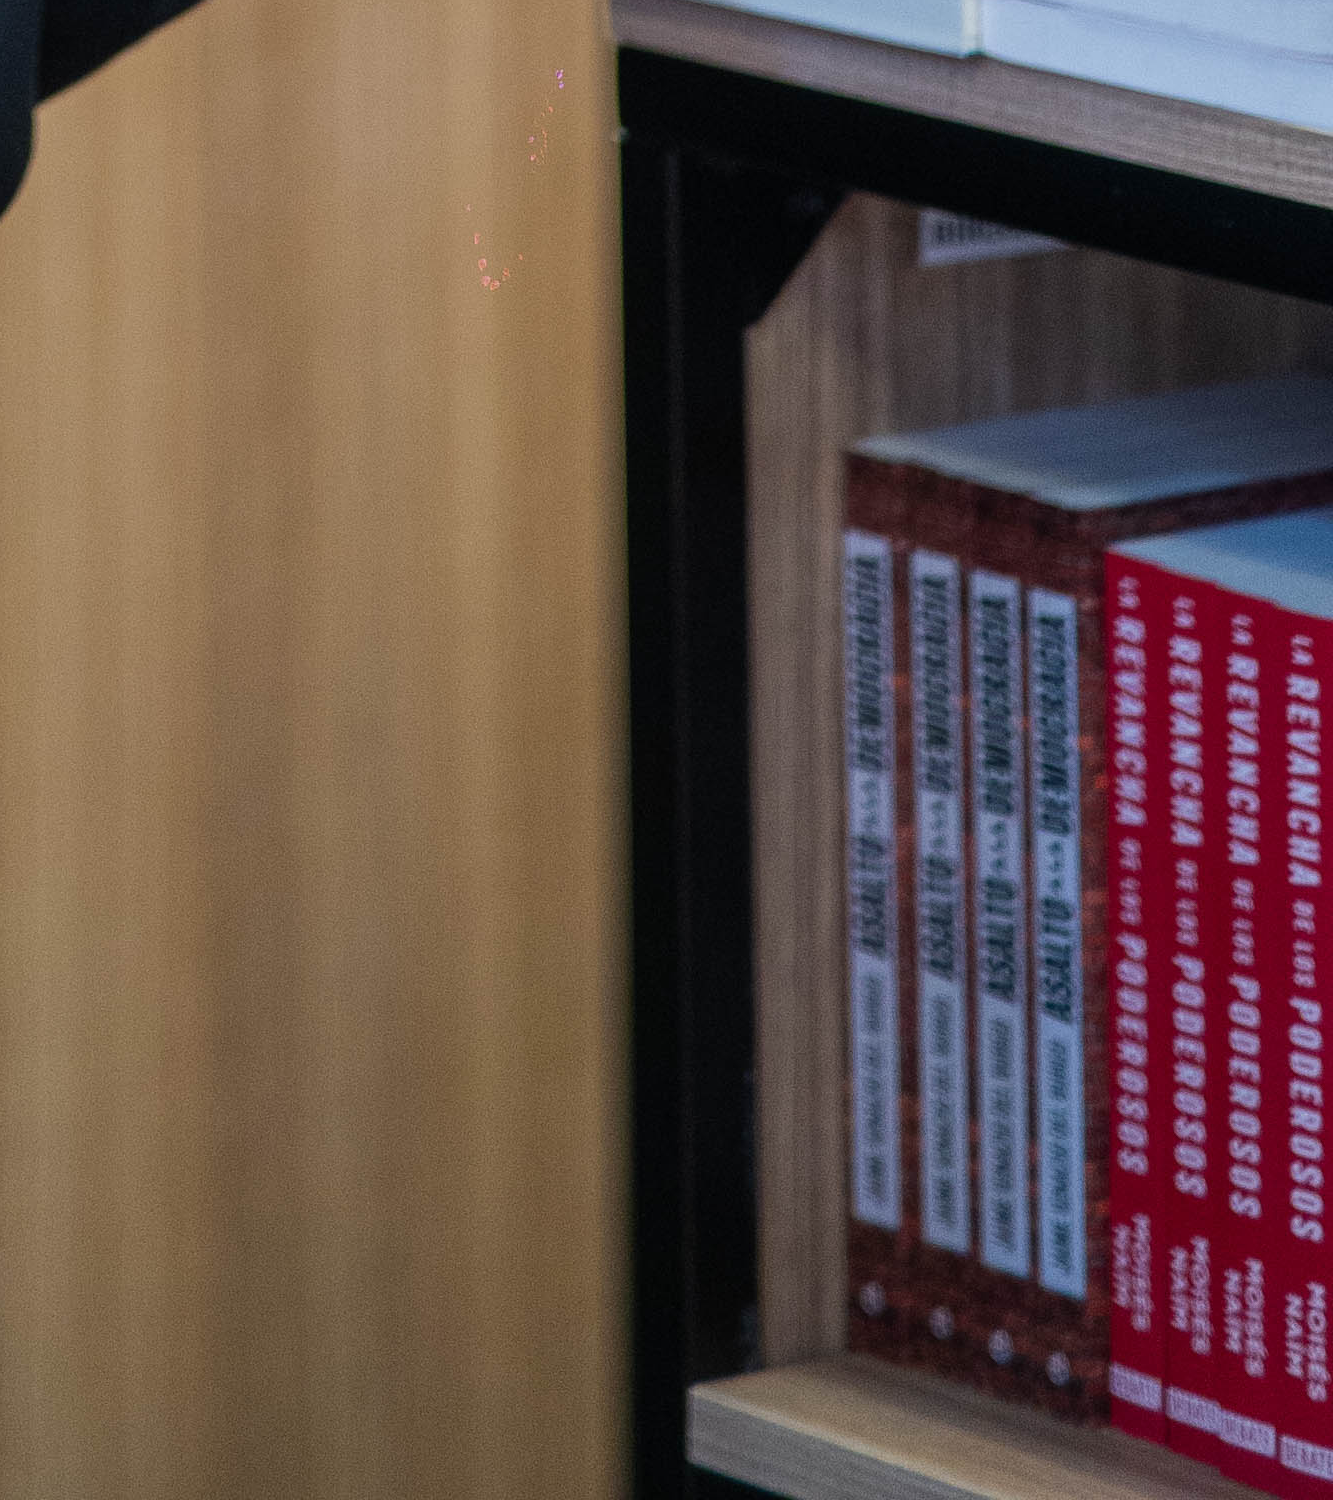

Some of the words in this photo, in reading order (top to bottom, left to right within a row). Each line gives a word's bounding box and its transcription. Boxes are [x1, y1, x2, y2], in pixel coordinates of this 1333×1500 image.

[1173, 596, 1195, 629] LA
[1231, 614, 1254, 646] LA
[1290, 634, 1314, 667] LA
[1114, 615, 1148, 827] REVANCHA
[1169, 634, 1203, 847] REVANCHA
[1226, 652, 1260, 866] REVANCHA
[1285, 673, 1321, 888] REVANCHA
[1176, 898, 1199, 947] LOS
[1232, 877, 1255, 912] DE
[1232, 917, 1255, 966] LOS
[1292, 899, 1315, 935] DE
[1042, 897, 1072, 1021] ASALTO
[1292, 939, 1316, 988] LOS
[1116, 932, 1149, 1175] PODEROSOS
[1171, 952, 1207, 1198] PODEROSOS
[1228, 974, 1262, 1219] PODEROSOS
[1288, 996, 1324, 1243] PODEROSOS
[1244, 1257, 1268, 1378] MOISÉS
[1285, 1293, 1303, 1380] NAÍM
[1306, 1281, 1330, 1402] MOISÉS
